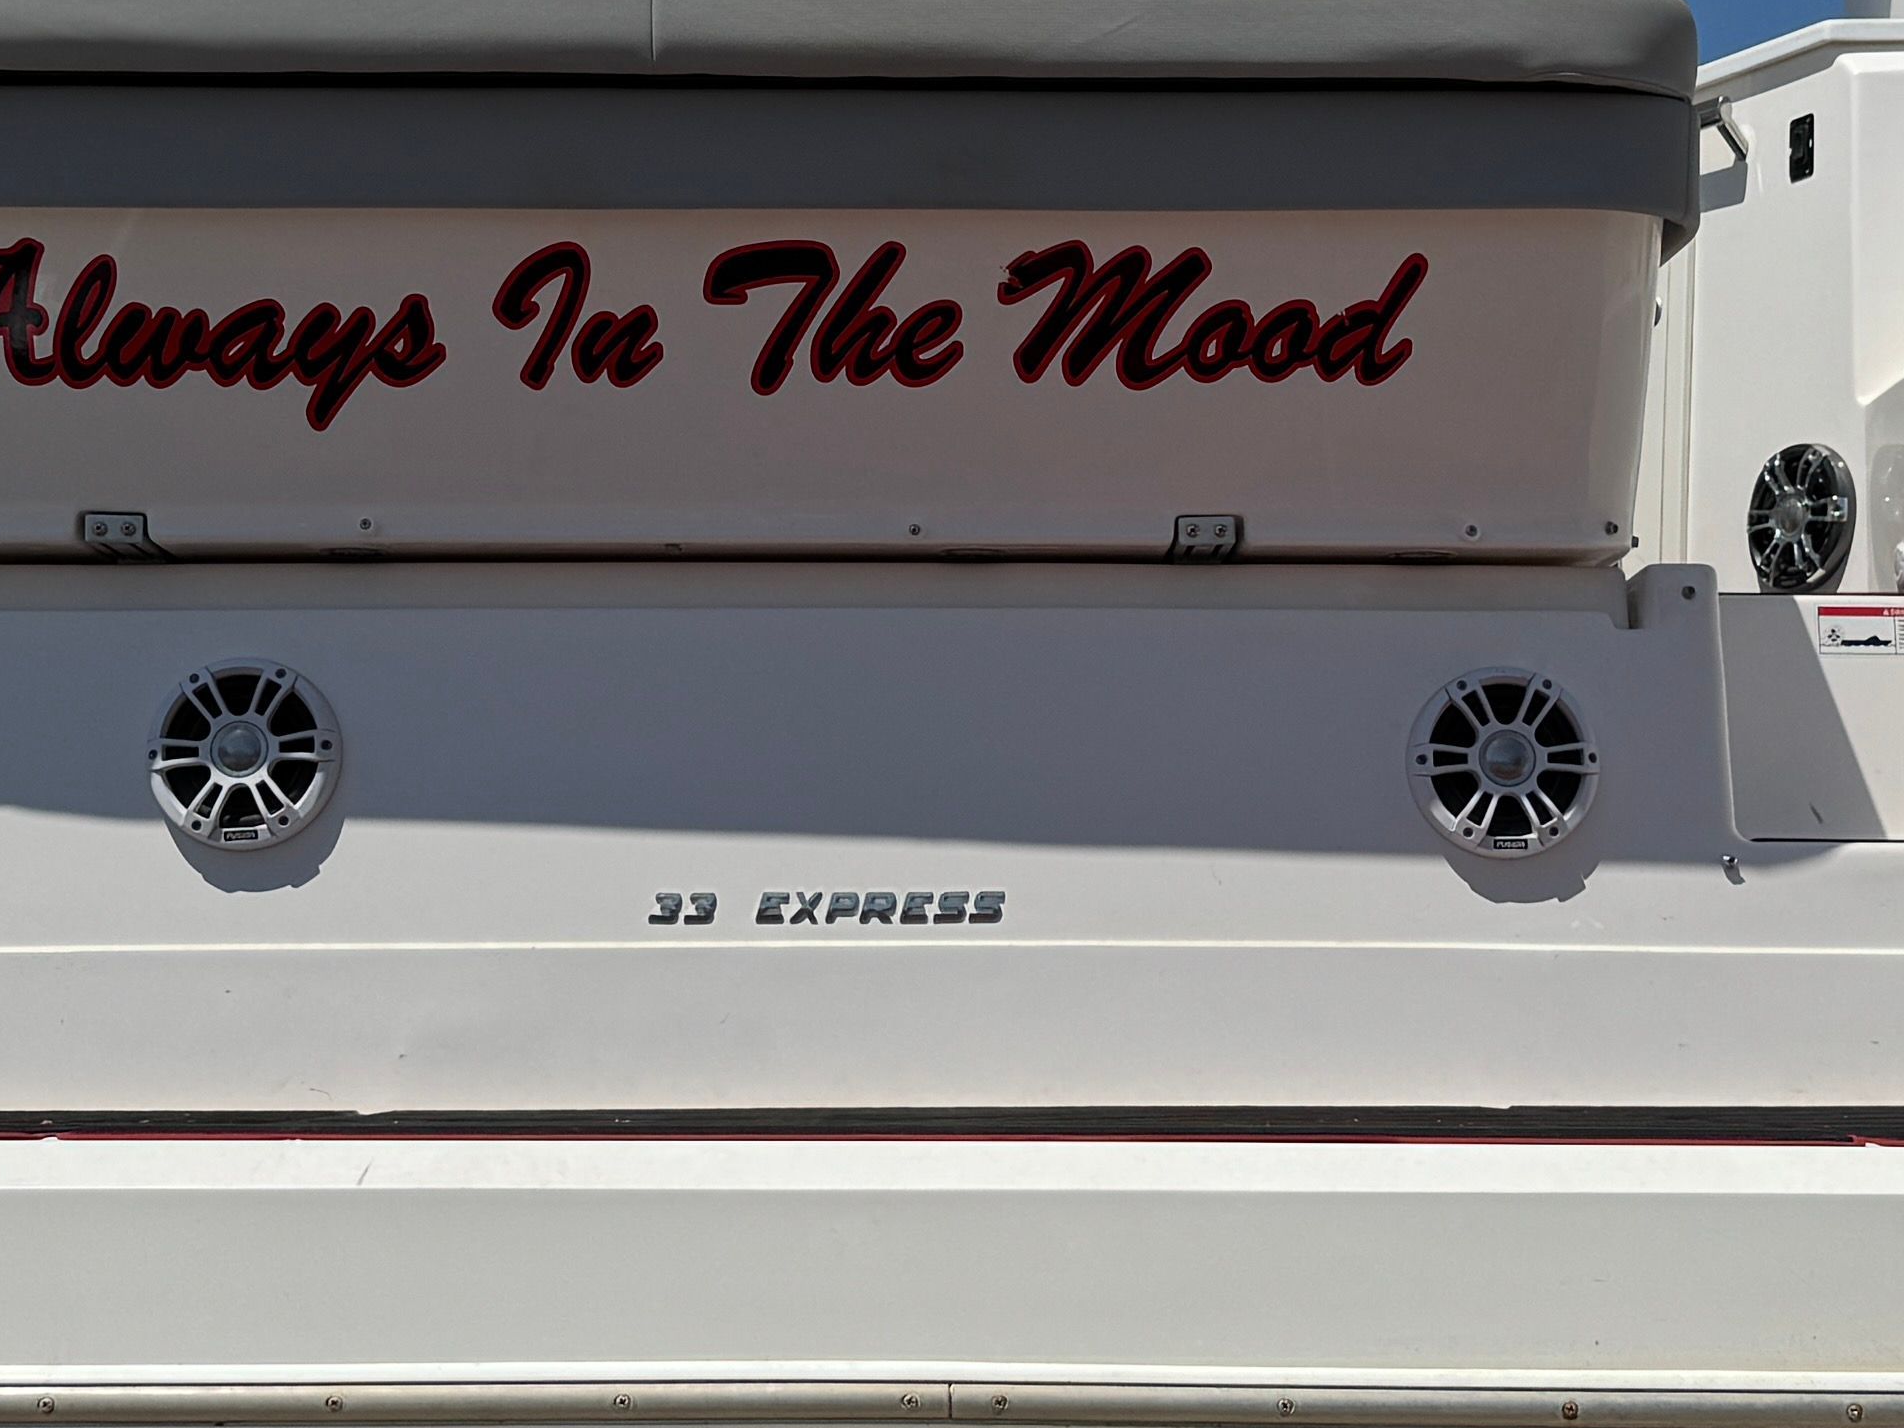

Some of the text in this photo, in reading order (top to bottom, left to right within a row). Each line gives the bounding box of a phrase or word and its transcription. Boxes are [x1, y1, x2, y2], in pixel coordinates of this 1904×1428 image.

[492, 241, 666, 389] In
[702, 240, 963, 395] The
[996, 239, 1429, 392] Mood
[647, 890, 1007, 925] 33 EXPRESS
